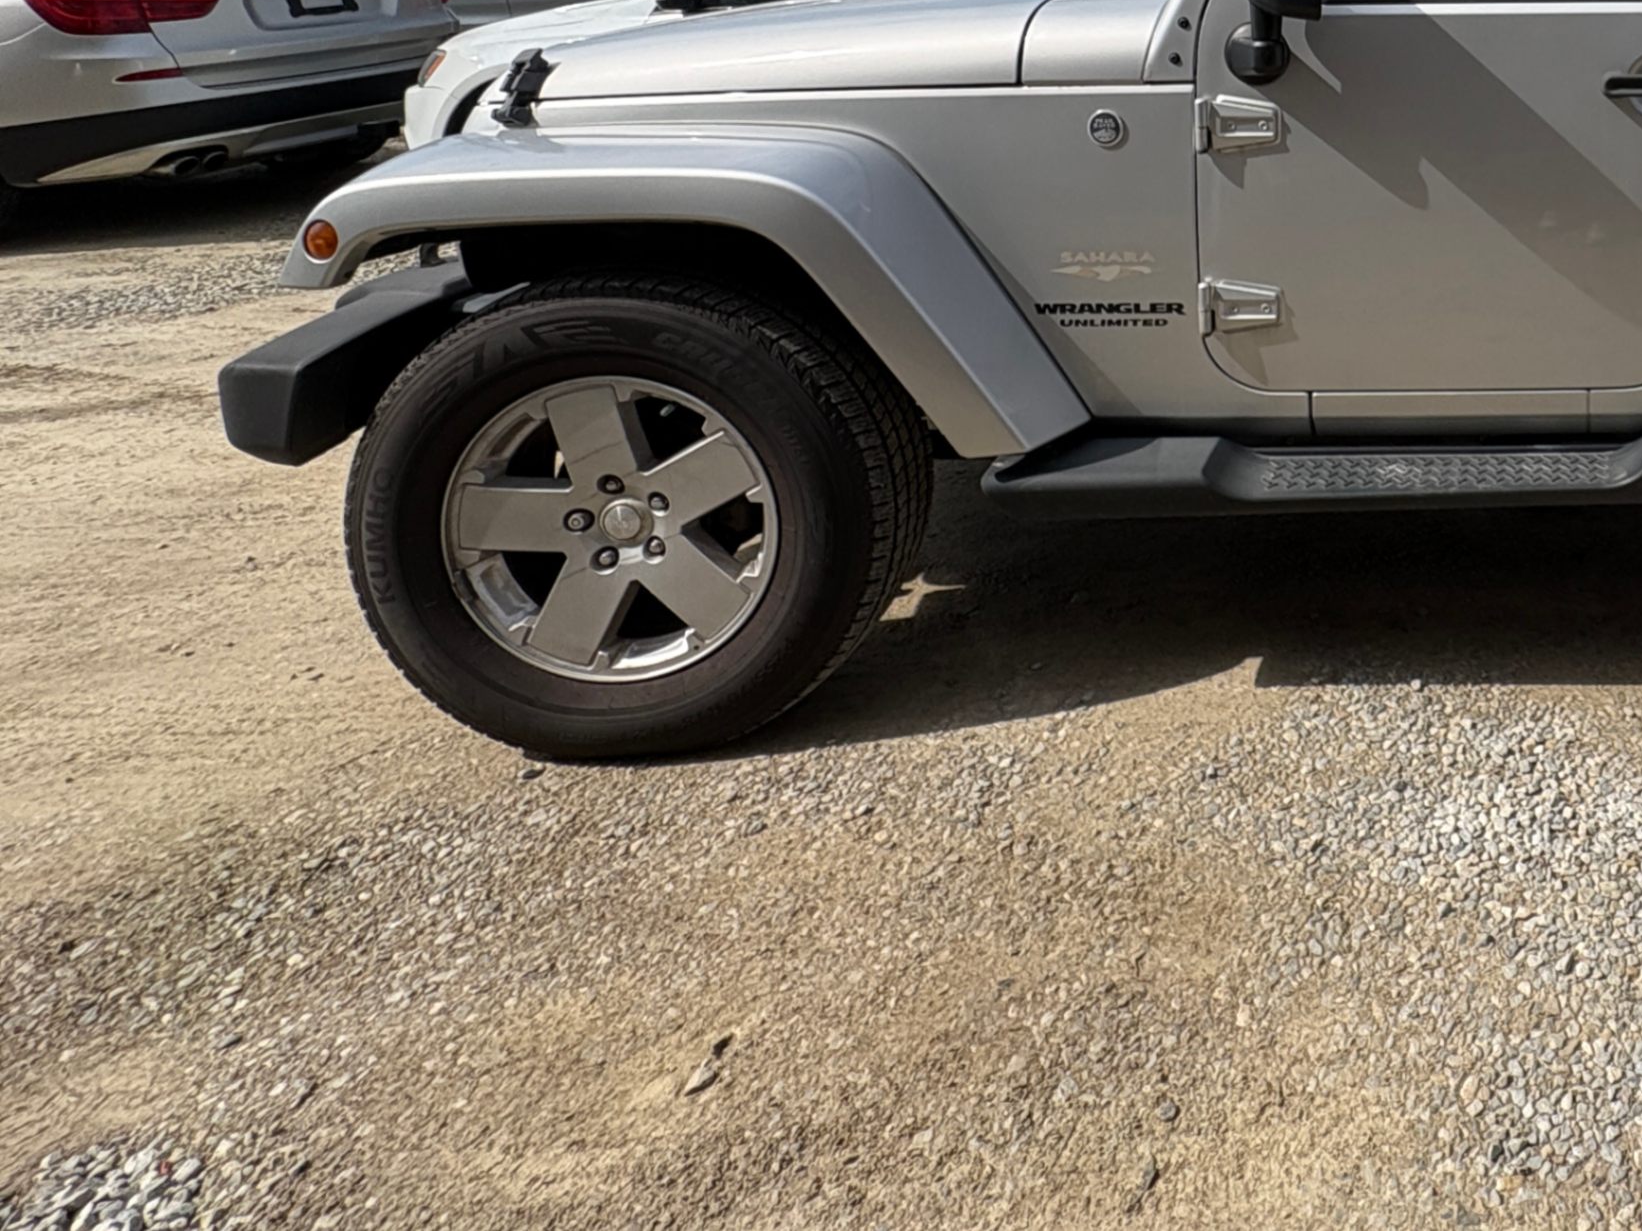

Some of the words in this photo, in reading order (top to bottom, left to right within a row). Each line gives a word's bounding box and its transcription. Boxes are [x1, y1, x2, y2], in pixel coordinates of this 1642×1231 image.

[1060, 251, 1155, 263] SAHARA
[1034, 302, 1187, 316] WRANGLER
[1060, 319, 1169, 328] UNLIMITED
[364, 467, 397, 605] KUMHO
